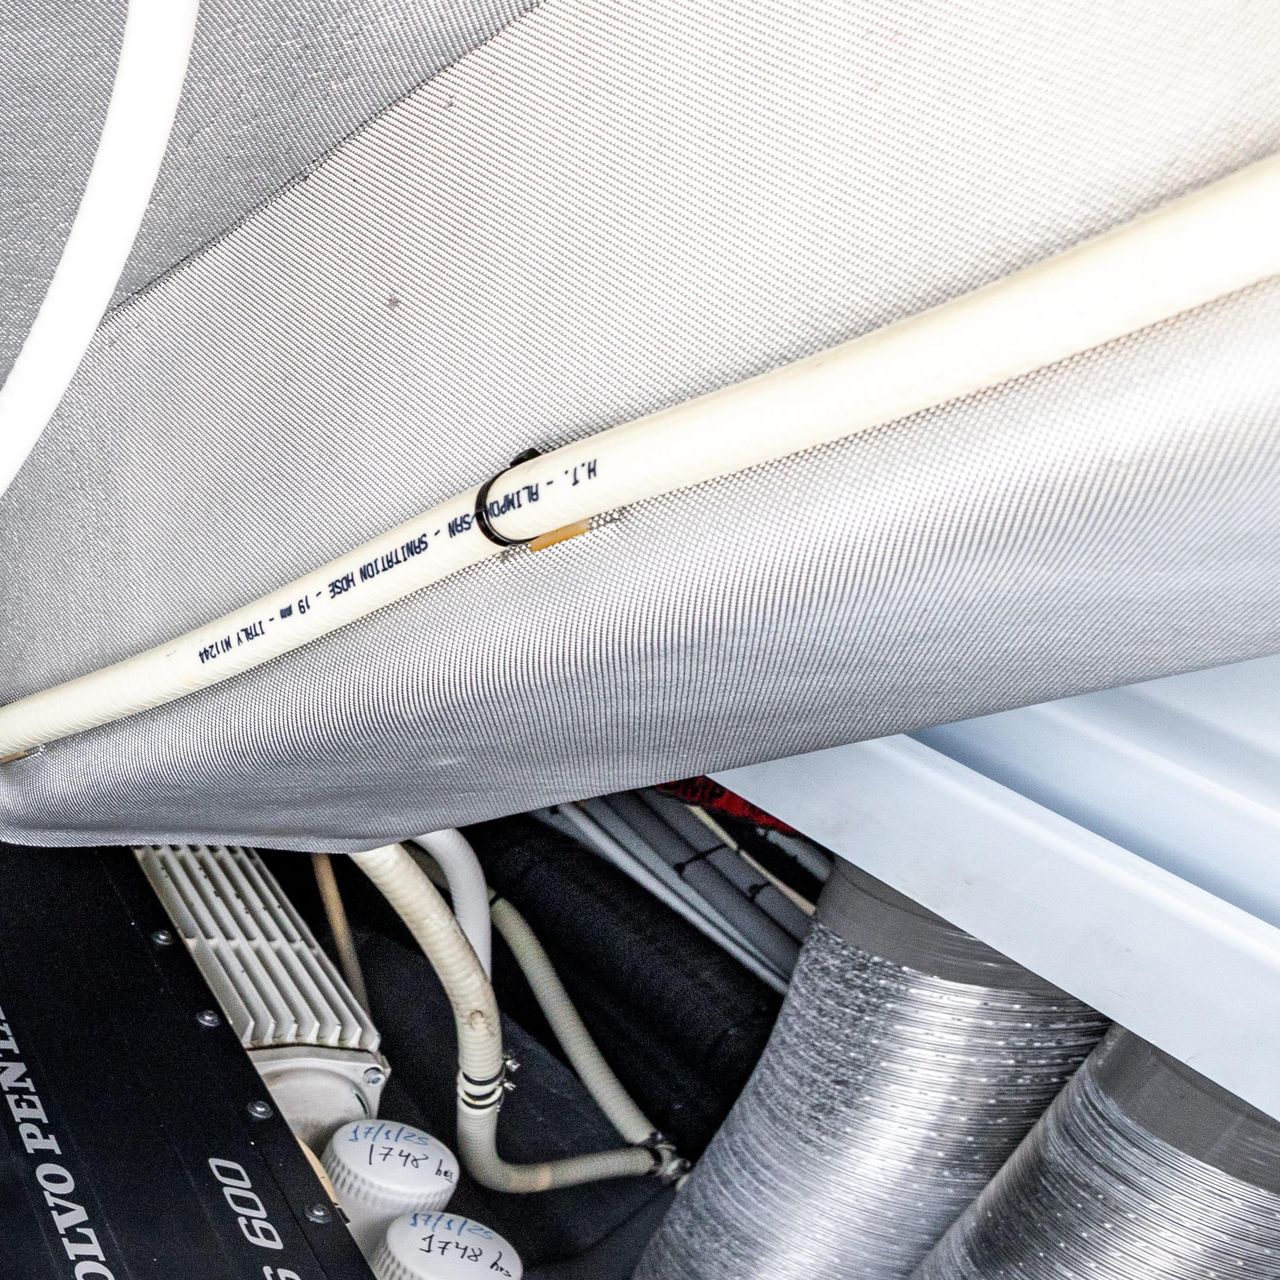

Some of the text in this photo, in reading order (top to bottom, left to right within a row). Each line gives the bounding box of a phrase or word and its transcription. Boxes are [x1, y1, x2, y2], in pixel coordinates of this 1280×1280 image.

[360, 533, 429, 581] SANITATION
[328, 570, 355, 599] HOSE
[298, 600, 311, 615] 19
[236, 622, 266, 648] ITALY
[368, 1144, 429, 1169] 1748
[208, 1157, 284, 1249] 600
[419, 1234, 483, 1262] 1748
